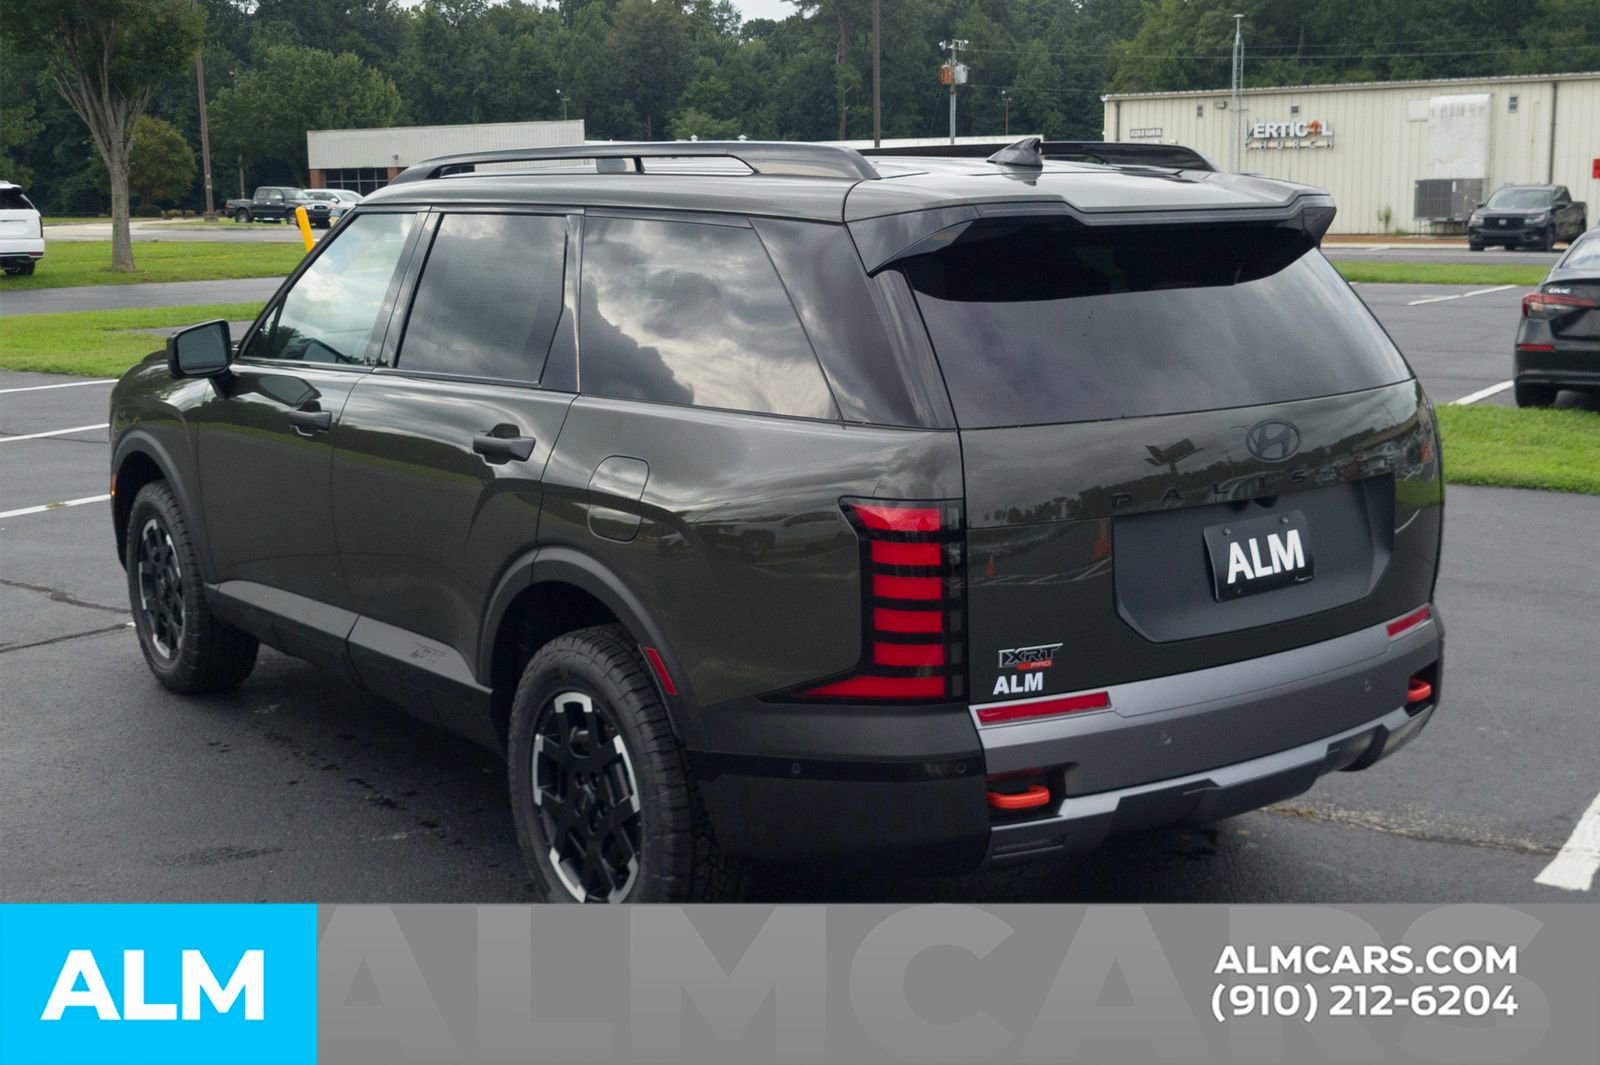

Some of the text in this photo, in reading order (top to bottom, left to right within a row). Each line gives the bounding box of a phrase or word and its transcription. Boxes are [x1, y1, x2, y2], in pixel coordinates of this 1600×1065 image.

[1245, 120, 1333, 138] VERTICL
[1227, 529, 1305, 584] ALM
[998, 643, 1063, 668] XRT
[993, 672, 1043, 695] ALM
